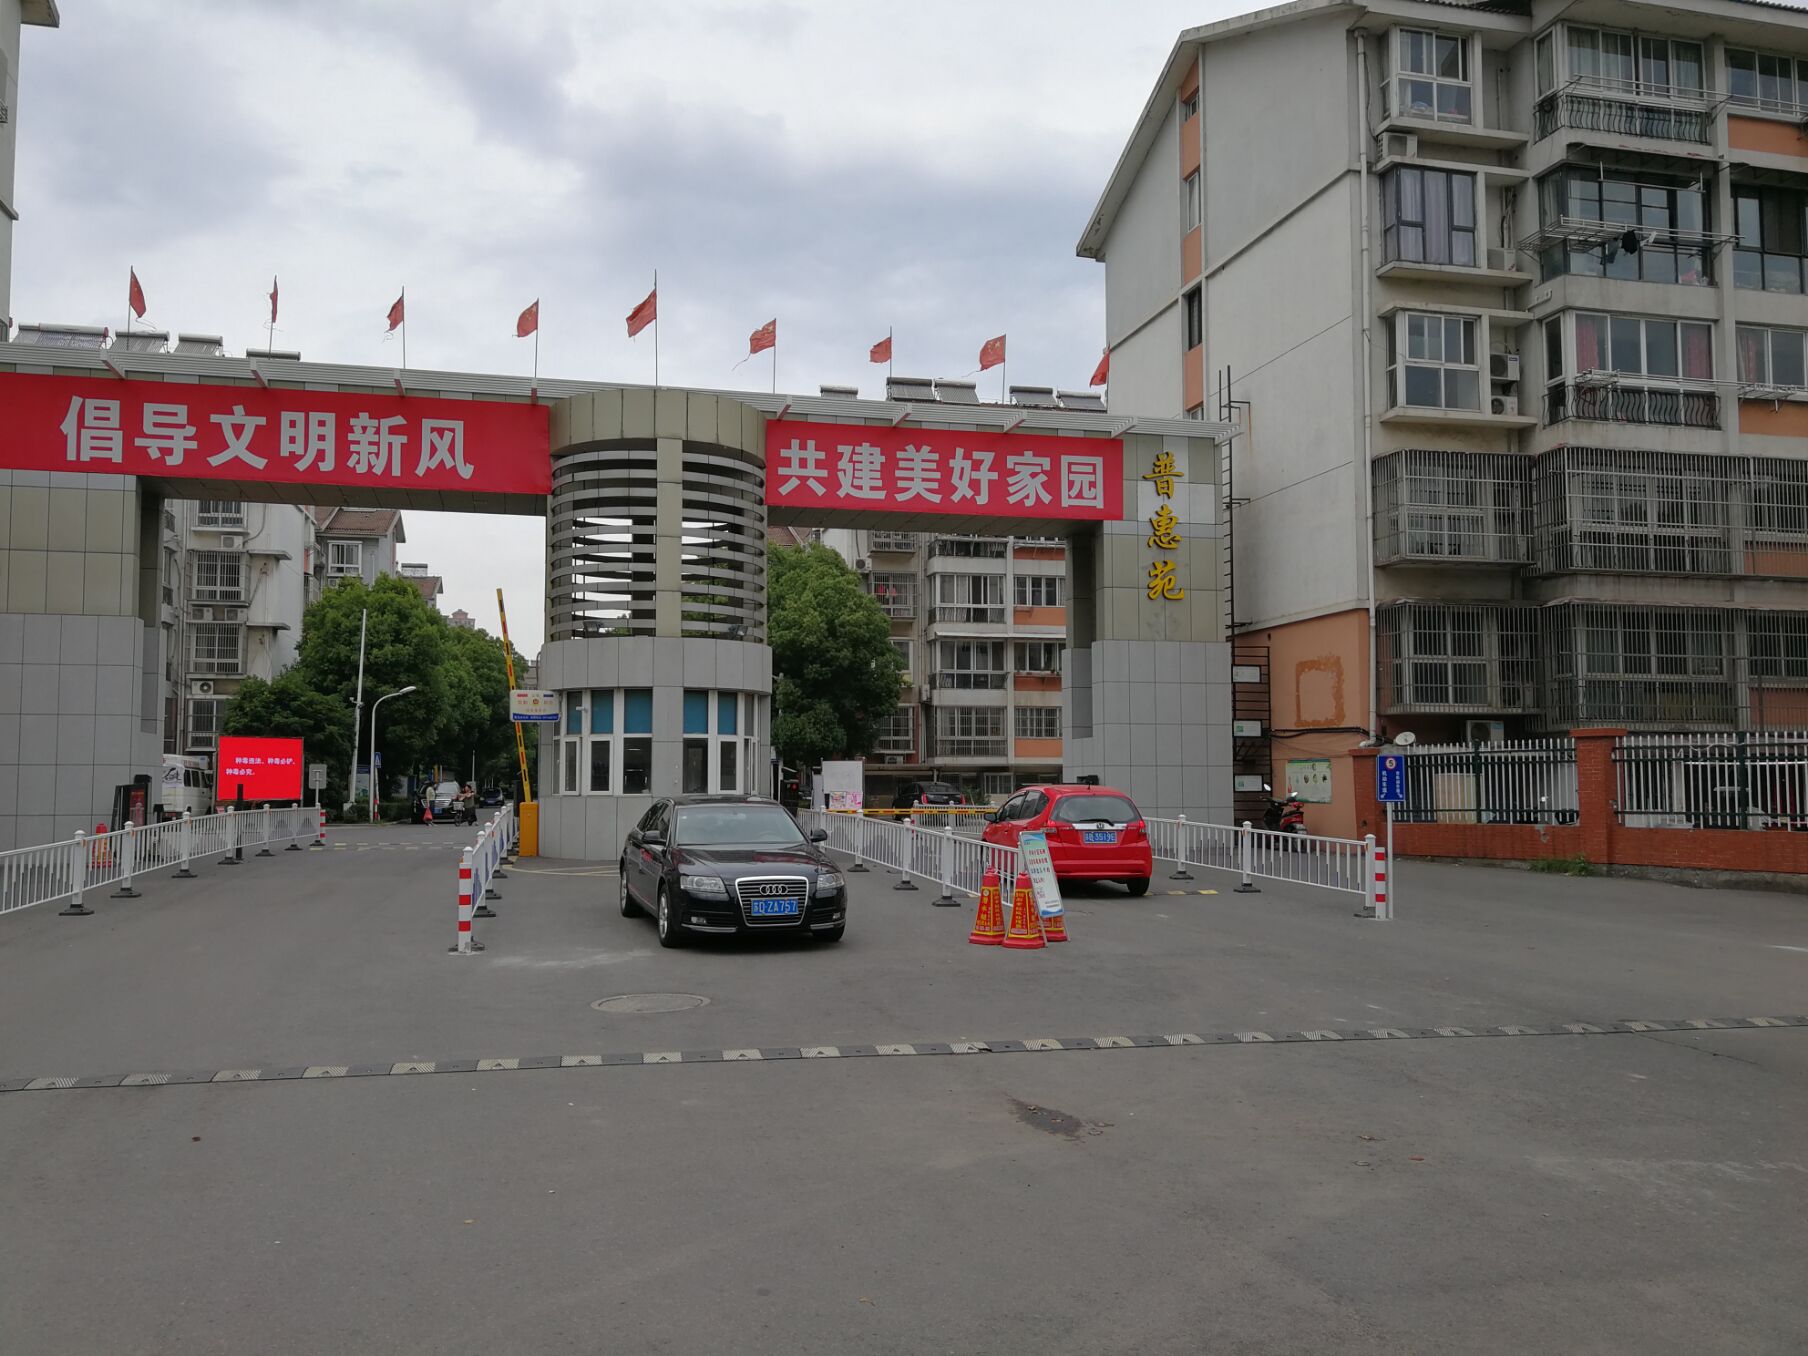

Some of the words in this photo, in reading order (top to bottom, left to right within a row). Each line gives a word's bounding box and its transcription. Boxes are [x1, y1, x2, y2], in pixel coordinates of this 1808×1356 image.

[60, 395, 475, 480] 倡导文明新风
[777, 438, 1105, 509] 共建美好家园
[1143, 451, 1185, 601] 普惠苑
